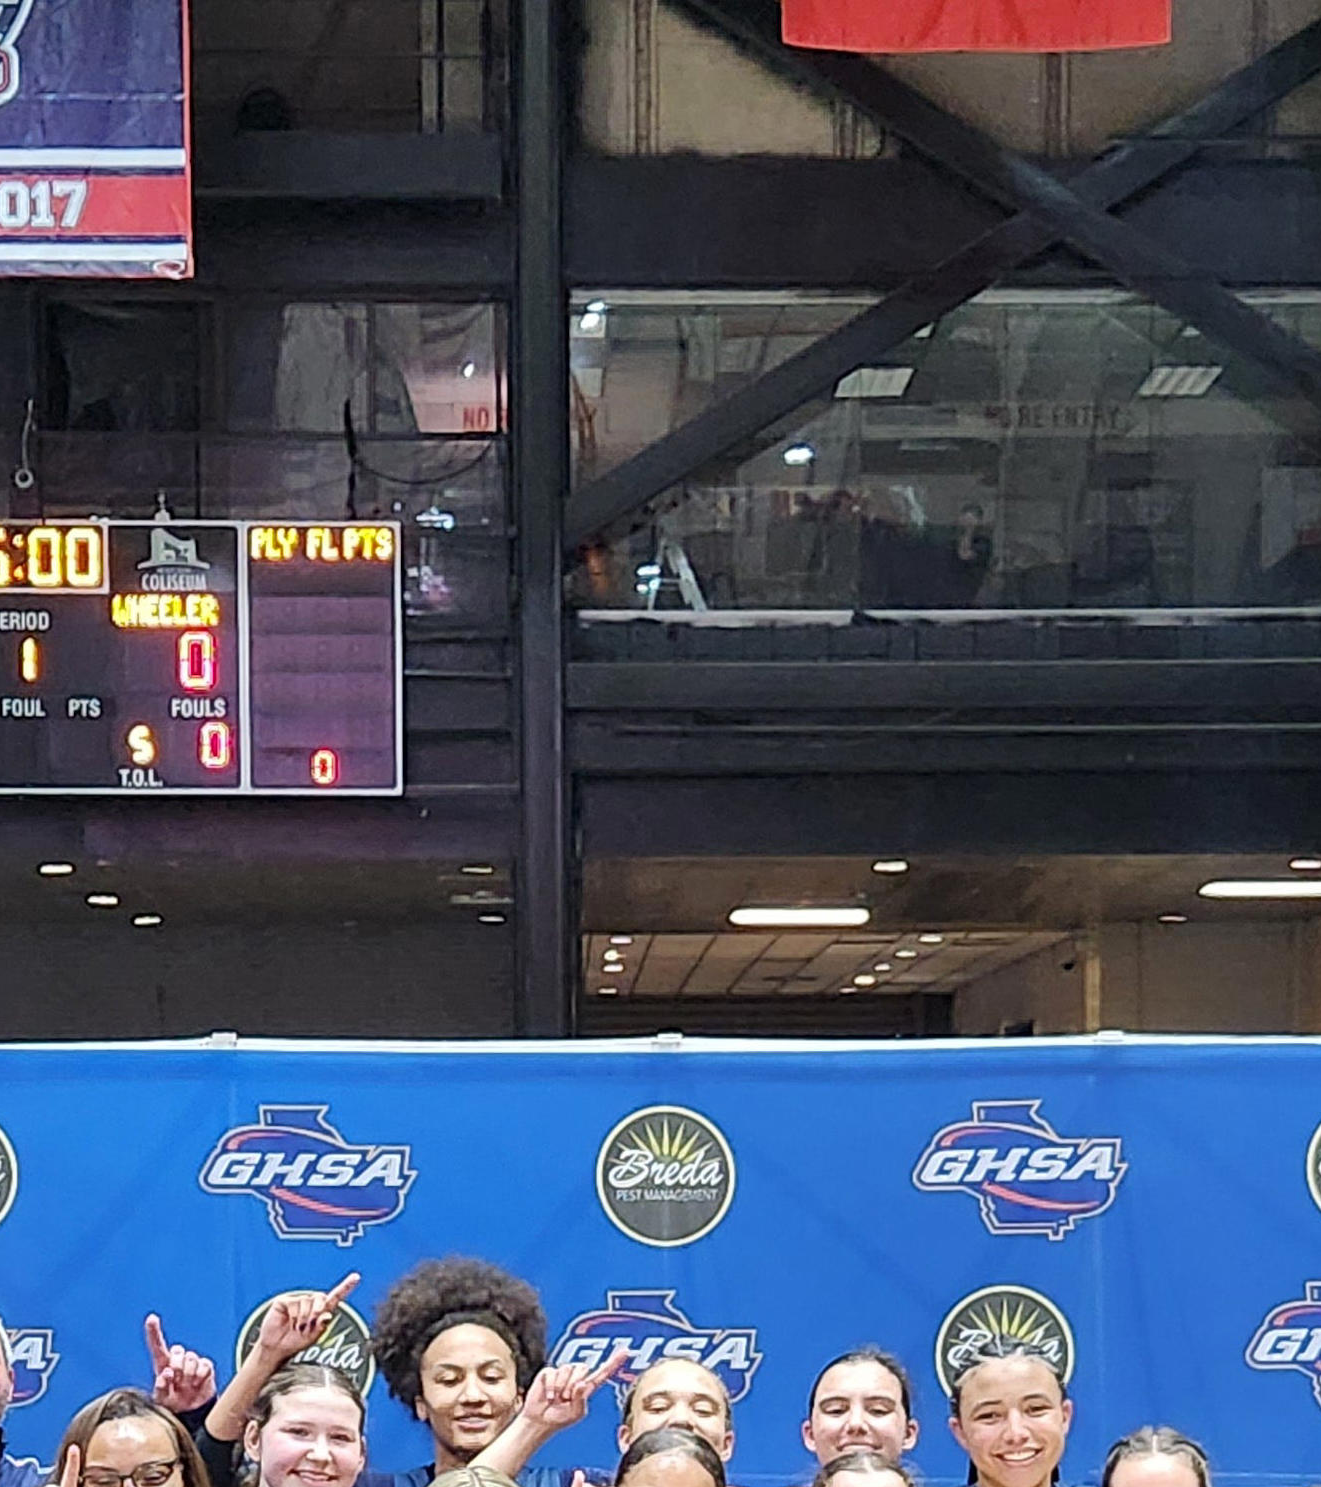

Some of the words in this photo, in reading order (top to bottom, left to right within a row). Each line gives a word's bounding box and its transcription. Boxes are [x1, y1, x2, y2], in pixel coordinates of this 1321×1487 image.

[250, 528, 298, 560] PLY
[306, 528, 338, 560] FL
[343, 528, 393, 560] PTS
[142, 573, 206, 591] COLISEUM
[112, 594, 219, 627] WHEELER
[21, 636, 40, 683] 1
[179, 630, 216, 690] 0
[2, 698, 46, 717] FOUL
[68, 698, 101, 718] PTS
[171, 698, 226, 718] FOULS
[200, 722, 230, 768] 0
[118, 769, 163, 787] T.O.L.
[311, 749, 337, 784] 0
[207, 1152, 404, 1187] GHSA
[608, 1149, 724, 1188] Breda
[920, 1145, 1116, 1183] GHSA
[616, 1188, 642, 1202] PEST
[643, 1188, 718, 1202] MANAGEMENT
